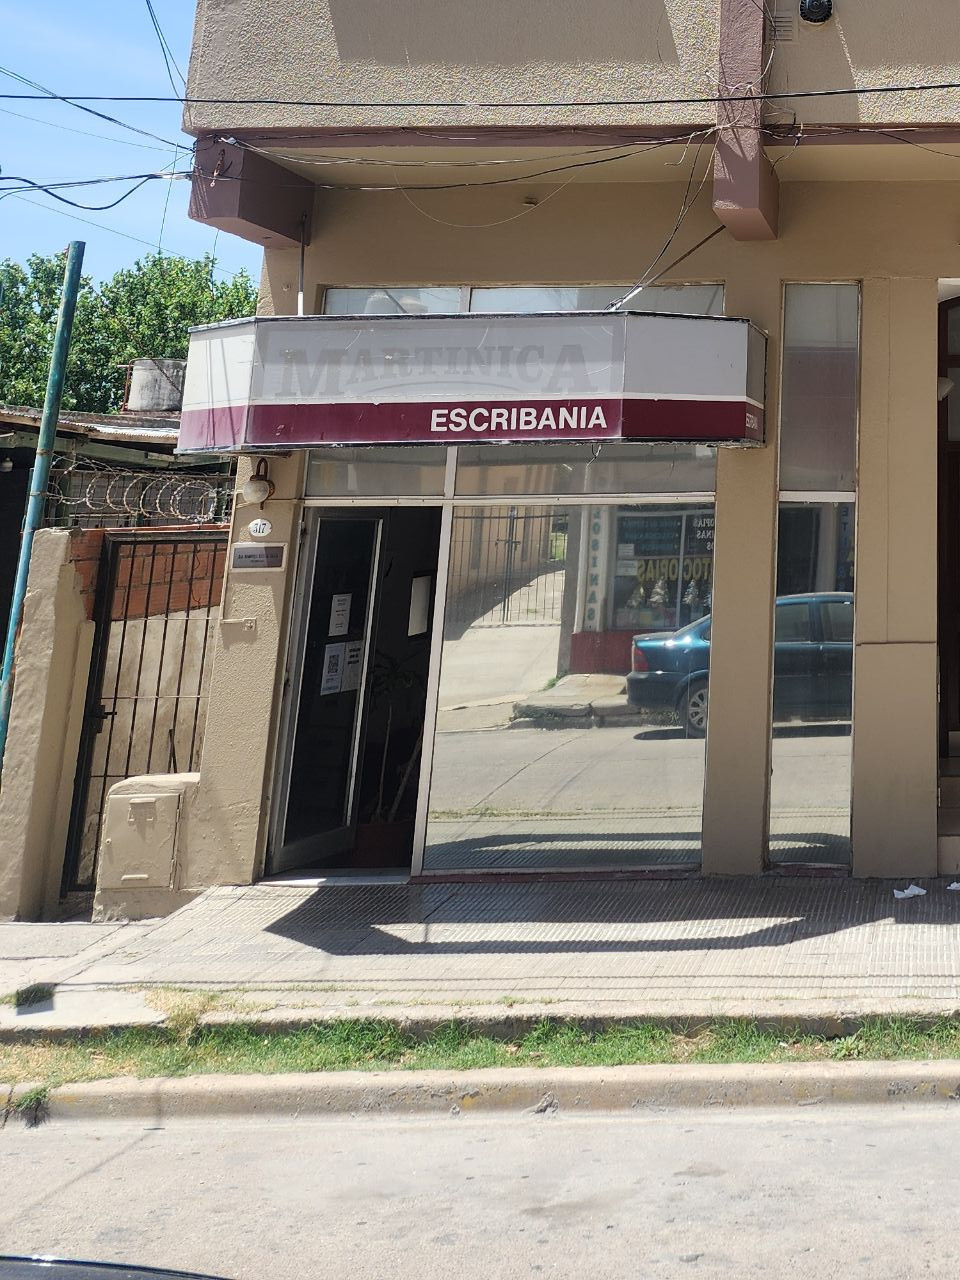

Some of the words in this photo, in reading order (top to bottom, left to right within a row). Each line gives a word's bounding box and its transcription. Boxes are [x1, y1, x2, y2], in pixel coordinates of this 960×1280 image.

[275, 342, 599, 397] MARTINICA
[430, 406, 607, 432] ESCRIBANIA
[252, 523, 267, 534] 317
